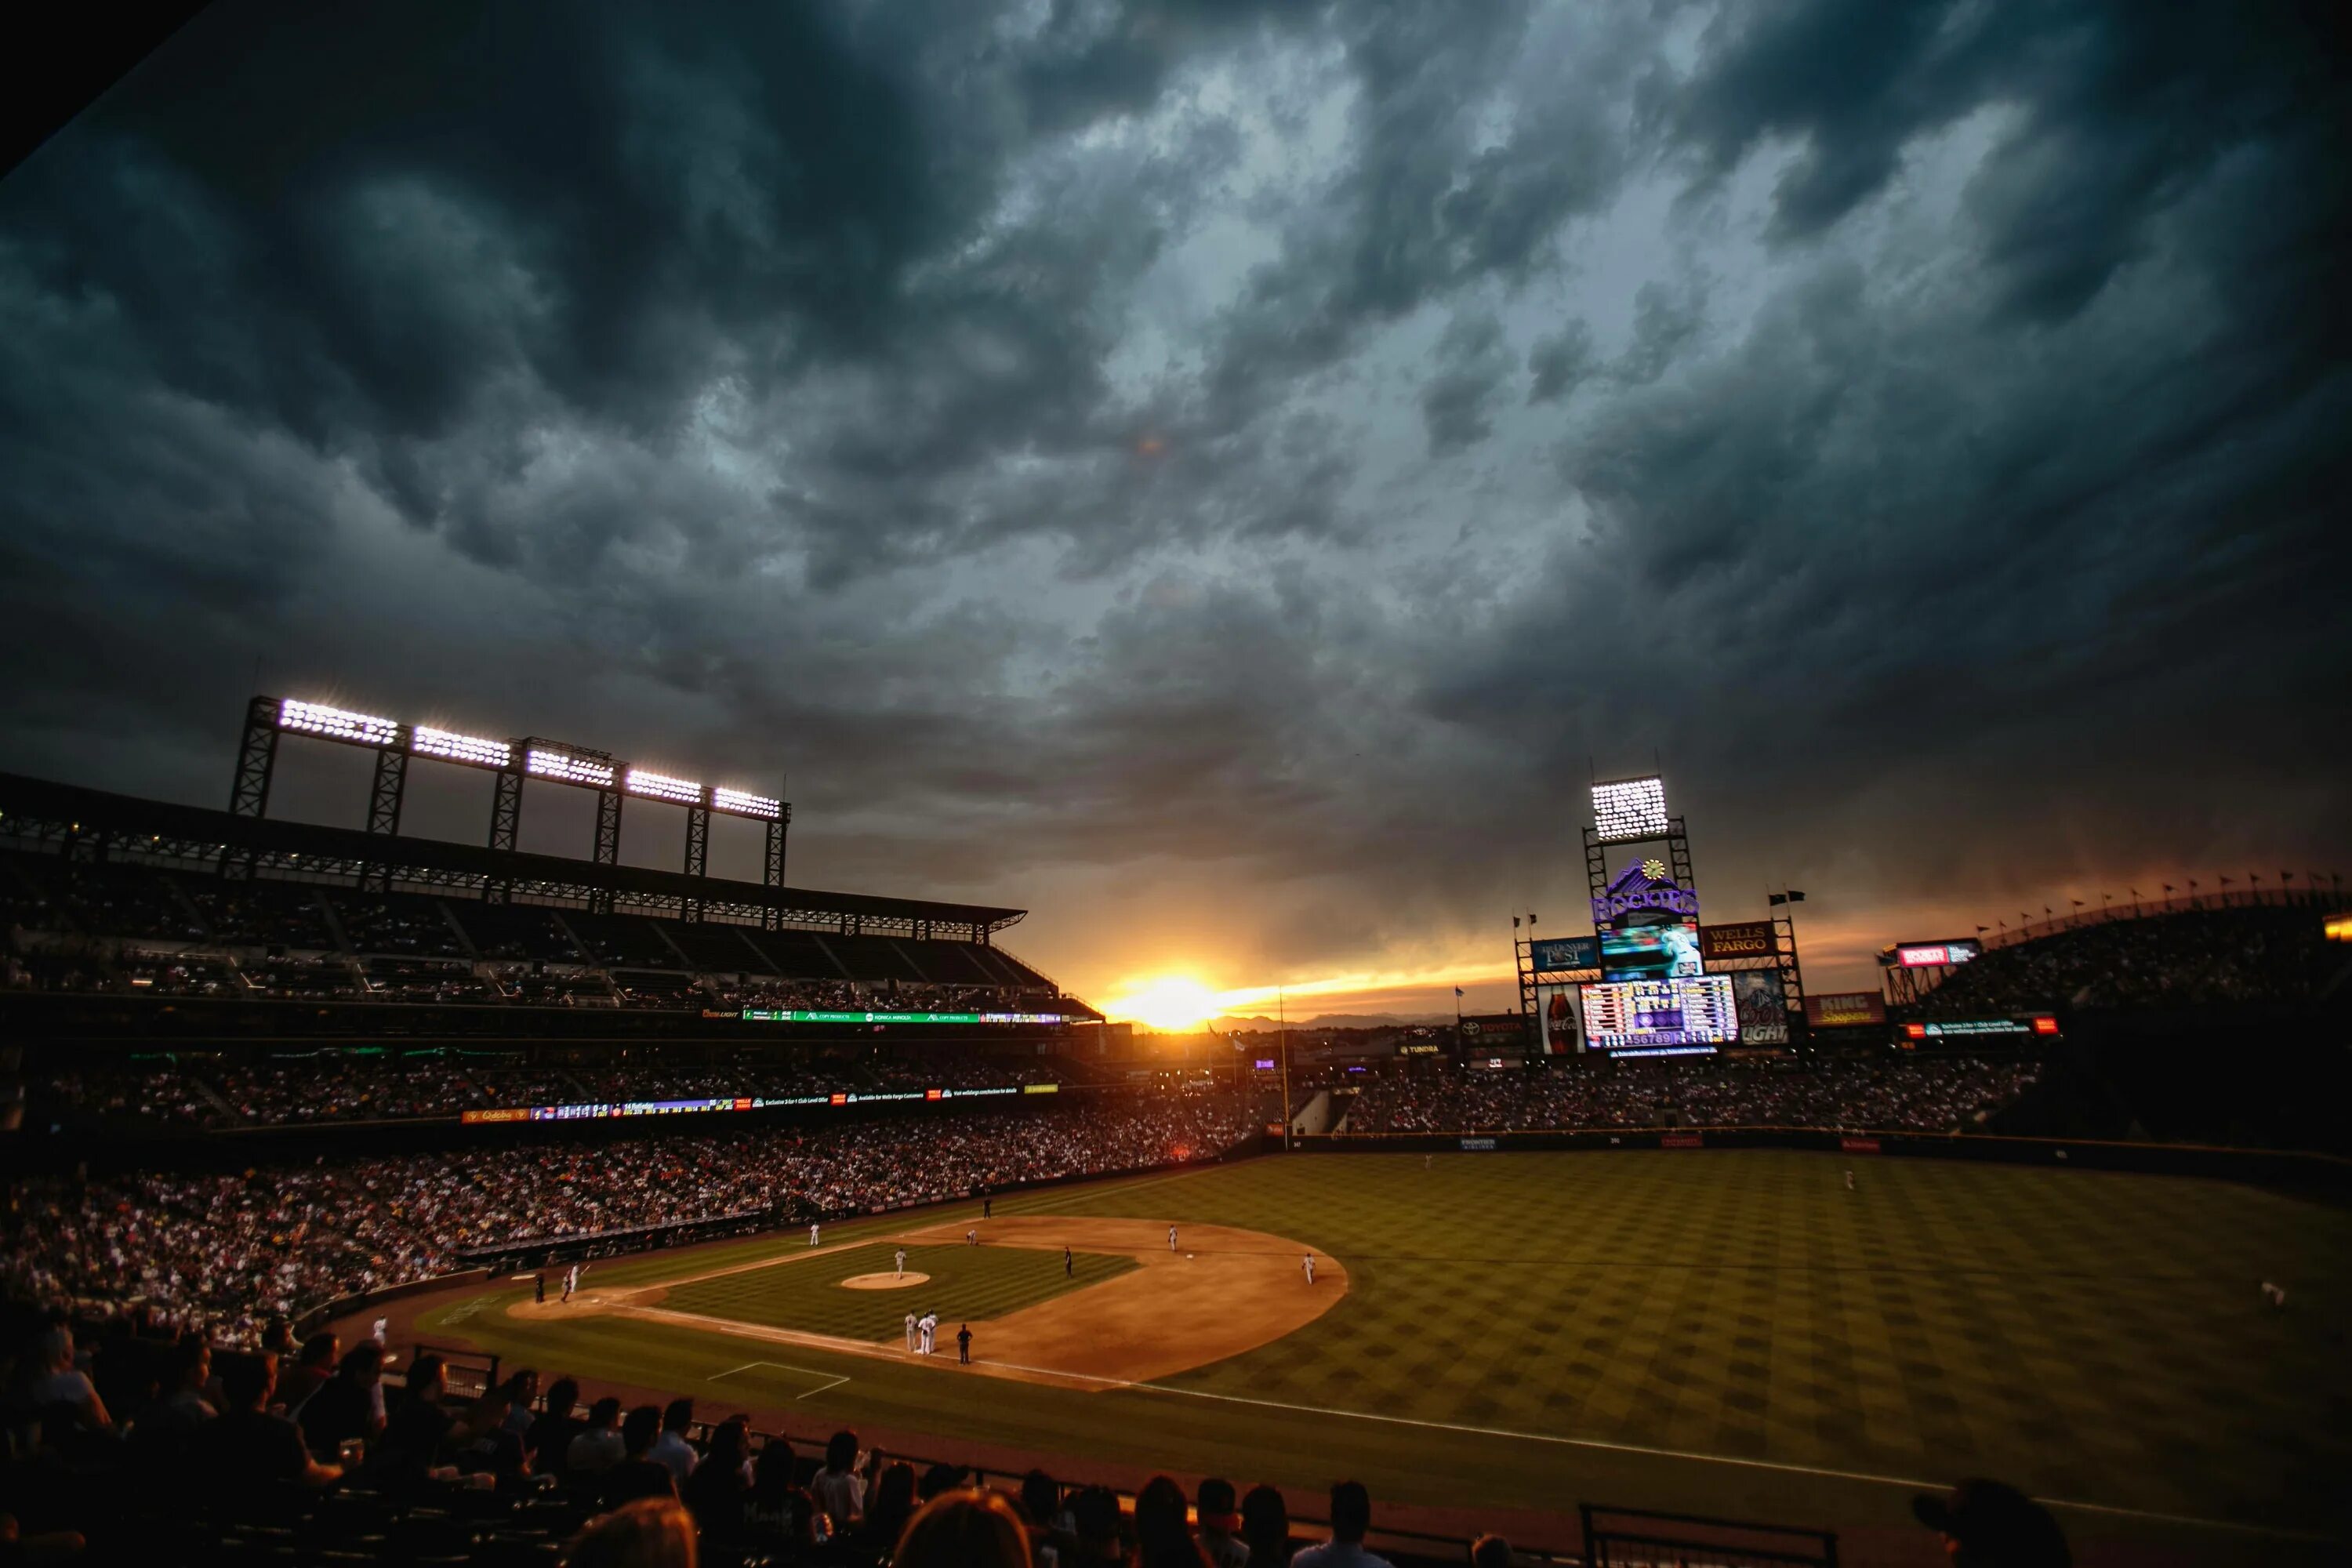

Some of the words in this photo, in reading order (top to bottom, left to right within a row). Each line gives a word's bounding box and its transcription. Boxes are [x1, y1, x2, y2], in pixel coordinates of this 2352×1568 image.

[1590, 890, 1700, 923] ROCKIES
[1710, 927, 1766, 941] WELLS
[1554, 942, 1590, 952] DENVER
[1713, 940, 1766, 953] FARGO
[1546, 950, 1581, 964] POST
[1820, 996, 1869, 1011] KING
[1482, 1023, 1523, 1033] TOYOTA
[1741, 1025, 1788, 1044] LIGHT
[1410, 1045, 1439, 1054] TUNDRA
[482, 1110, 512, 1121] Qdoba
